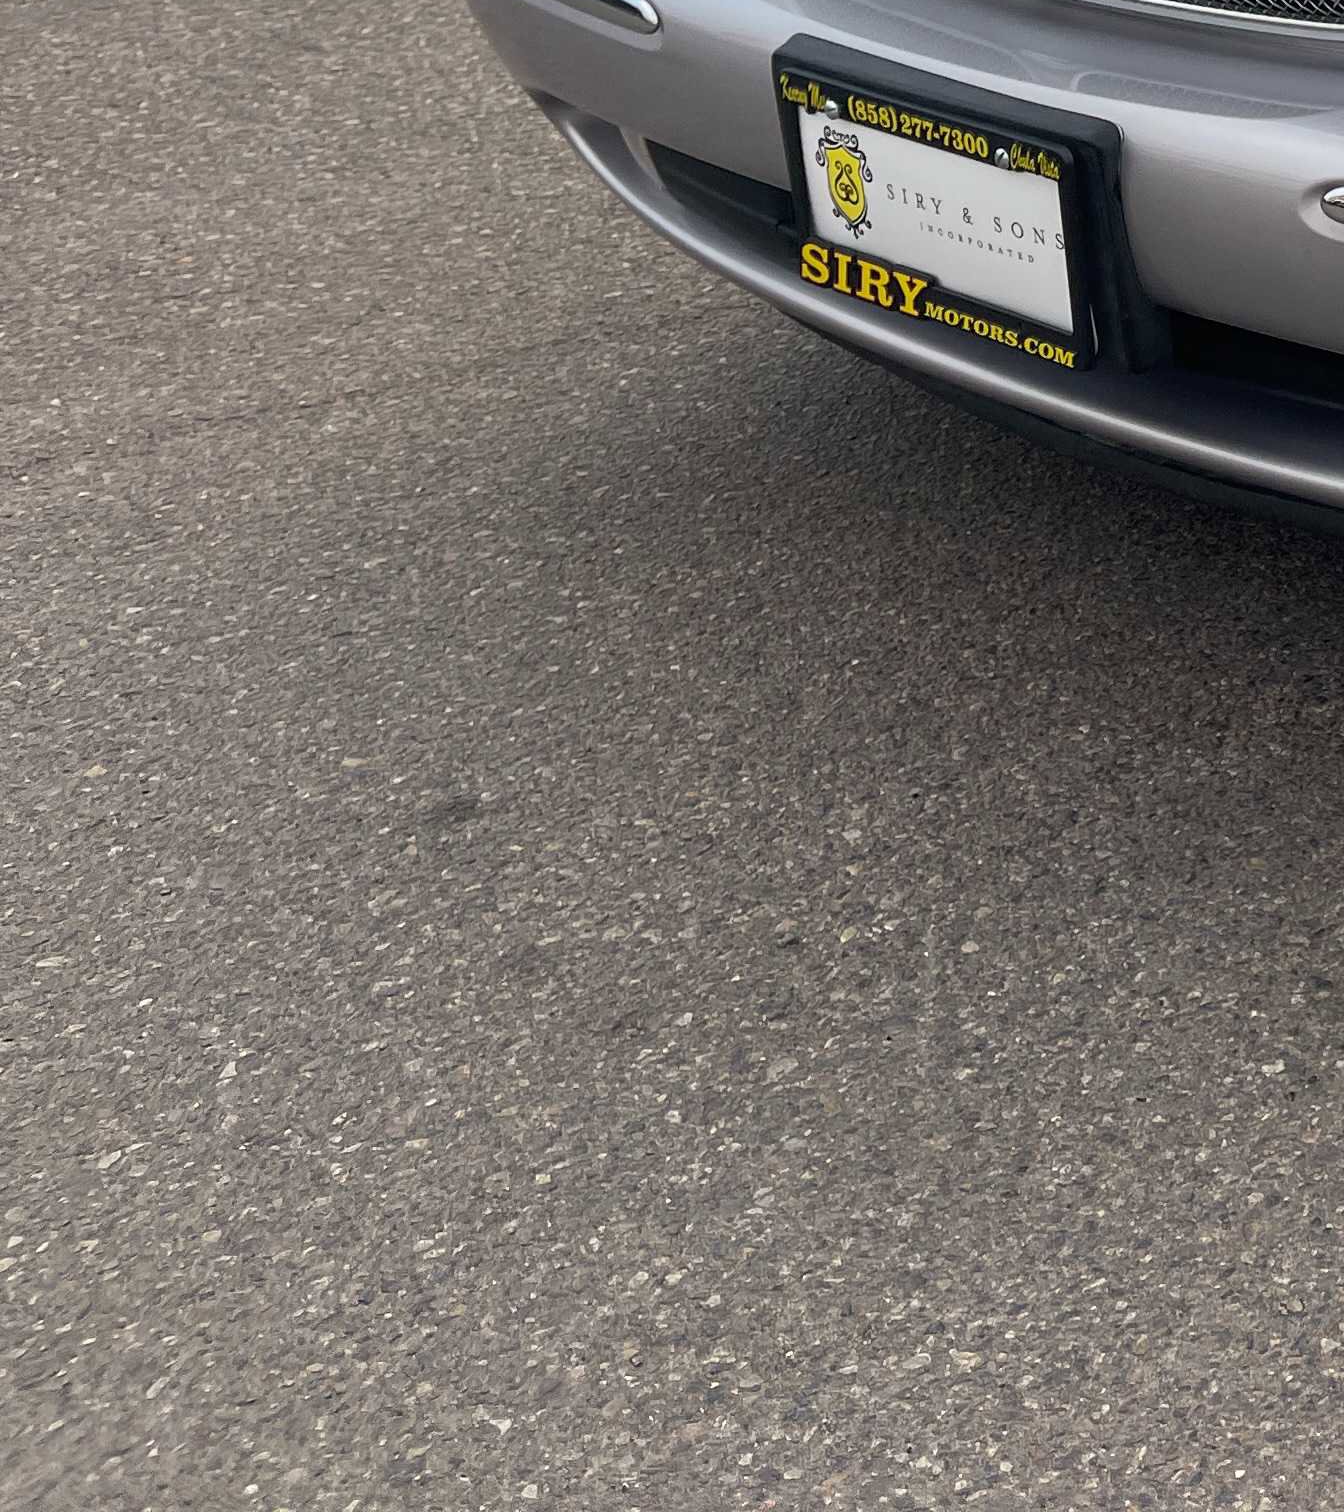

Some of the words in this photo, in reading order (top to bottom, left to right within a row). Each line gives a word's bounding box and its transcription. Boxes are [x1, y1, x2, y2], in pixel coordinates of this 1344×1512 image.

[848, 95, 899, 132] (858)
[900, 113, 990, 159] 277-7300
[886, 183, 943, 215] SIRY
[962, 207, 974, 226] &
[993, 216, 1066, 250] SONS
[919, 221, 1035, 264] INCORPORATED
